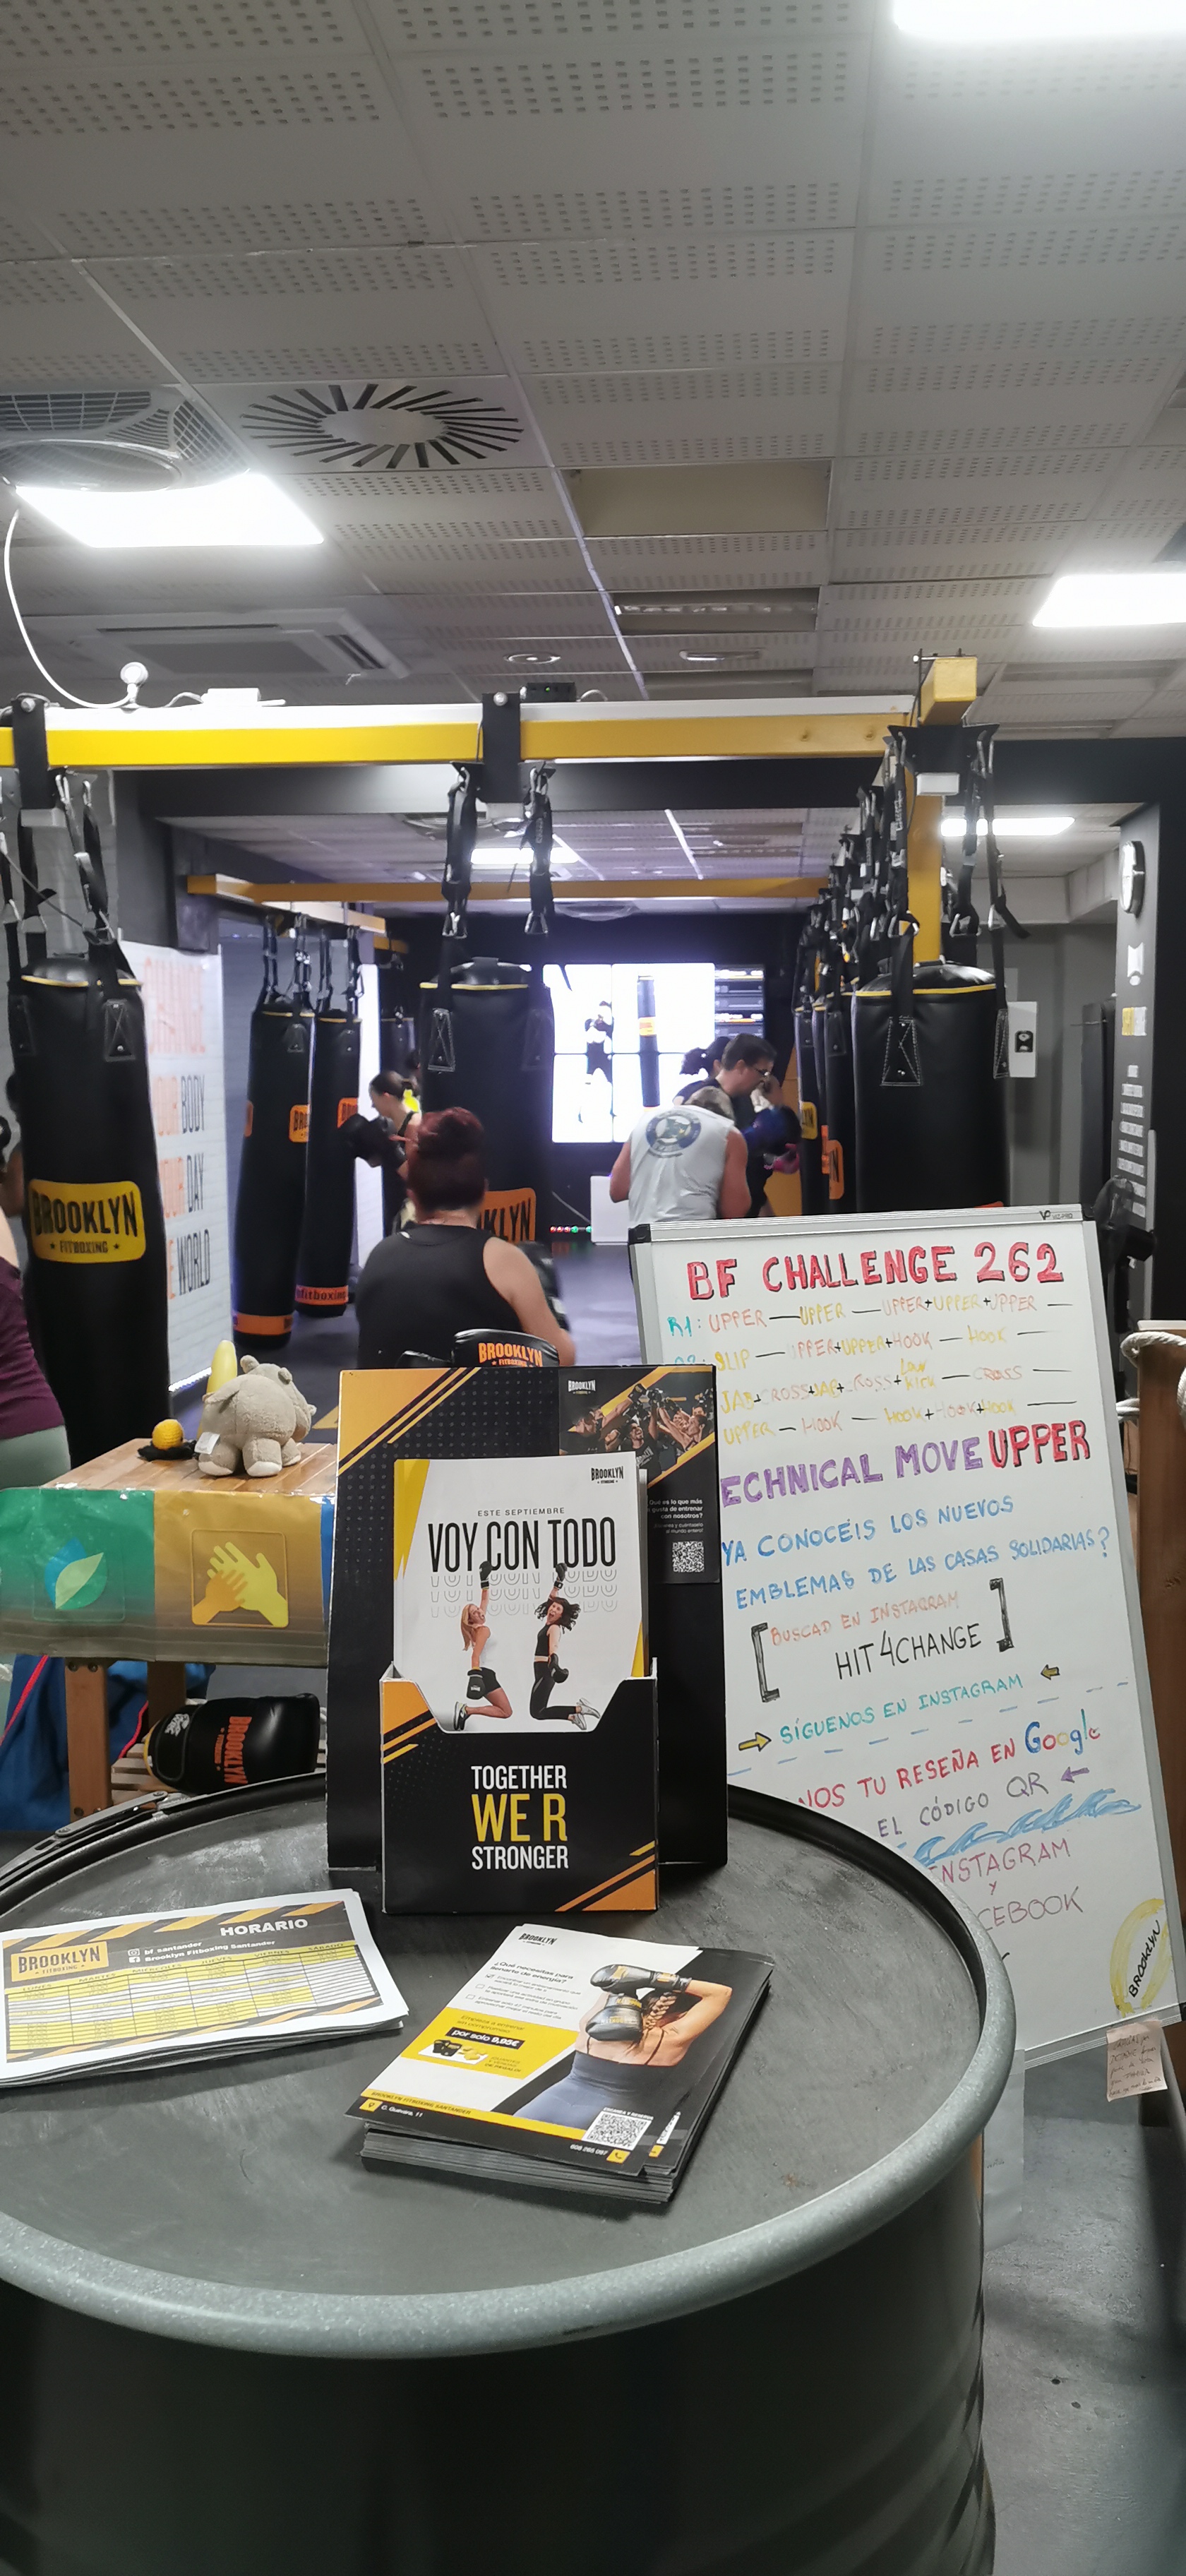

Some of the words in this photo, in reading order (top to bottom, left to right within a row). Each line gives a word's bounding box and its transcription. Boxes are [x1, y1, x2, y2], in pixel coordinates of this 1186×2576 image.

[181, 1075, 205, 1133] BODY
[186, 1152, 204, 1212] DAY
[32, 1188, 138, 1237] BROOKLYN
[480, 1197, 532, 1241] KLYN
[59, 1240, 109, 1253] FITBOXING
[176, 1229, 210, 1296] WORLD
[686, 1258, 738, 1300] BF
[762, 1245, 957, 1293] CHALLENGE
[974, 1241, 1065, 1283] 262
[708, 1308, 767, 1333] UPPER
[798, 1302, 846, 1326] UPPER
[882, 1296, 929, 1316] UPPER
[933, 1294, 981, 1312] UPPER
[478, 1342, 544, 1367] BROOKLYN
[714, 1348, 750, 1372] SLIP
[892, 1331, 933, 1350] HOOK
[966, 1325, 1007, 1345] HOOK
[568, 1379, 597, 1392] BROOKLYN
[722, 1419, 776, 1446] UPPER
[801, 1410, 844, 1435] HOOK
[883, 1407, 926, 1426] HOOK
[591, 1465, 624, 1481] BROOKLYN
[720, 1452, 885, 1508] ECHNICAL
[894, 1436, 984, 1480] MOVE
[988, 1419, 1091, 1469] UPPER
[477, 1509, 501, 1517] ESTE
[505, 1506, 565, 1516] SEPTIEMBRE
[721, 1539, 748, 1567] YA
[890, 1508, 929, 1535] LOS
[937, 1494, 1015, 1525] NUEVOS
[428, 1522, 479, 1573] VOY
[486, 1520, 540, 1572] CON
[547, 1516, 616, 1569] TODO
[736, 1570, 855, 1611] EMBLEMAS
[868, 1561, 899, 1587] DE
[908, 1554, 938, 1578] LAS
[944, 1546, 1001, 1572] CASAS
[1010, 1526, 1112, 1562] SOLIDARIAS?
[770, 1619, 833, 1647] BUSCAD
[840, 1610, 863, 1631] EN
[870, 1590, 960, 1624] INSTAGRAM
[779, 1706, 877, 1746] SÍGUENOS
[882, 1698, 909, 1721] EN
[918, 1673, 1025, 1711] INSTAGRAM
[224, 1716, 253, 1784] BROOKLYN
[856, 1775, 887, 1799] TU
[895, 1748, 980, 1791] RESEÑA
[990, 1737, 1017, 1763] EN
[1023, 1707, 1103, 1757] Google
[471, 1765, 568, 1790] TOGETHER
[471, 1793, 531, 1842] WE
[543, 1793, 569, 1842] R
[877, 1815, 903, 1837] EL
[918, 1791, 990, 1827] CÓDIGO
[1005, 1771, 1051, 1799] QR
[471, 1844, 570, 1871] STRONGER
[928, 1837, 1072, 1885] NSTAGRAM
[220, 1919, 309, 1937] HORARIO
[977, 1885, 1084, 1932] CEBOOK
[18, 1945, 101, 1974] BROOKLYN
[145, 1951, 185, 1962] Brooklyn
[186, 1943, 229, 1957] Fitboxing
[230, 1940, 276, 1950] Santander
[518, 1933, 558, 1945] BROOKLYN
[489, 1965, 520, 1974] llenarte
[532, 1973, 568, 1984] energía?
[516, 1964, 555, 1976] necesitas
[469, 2033, 491, 2042] solo
[371, 2091, 402, 2101] BROOKLYN
[402, 2096, 434, 2109] FITBOXING
[434, 2103, 472, 2116] SANTANDER
